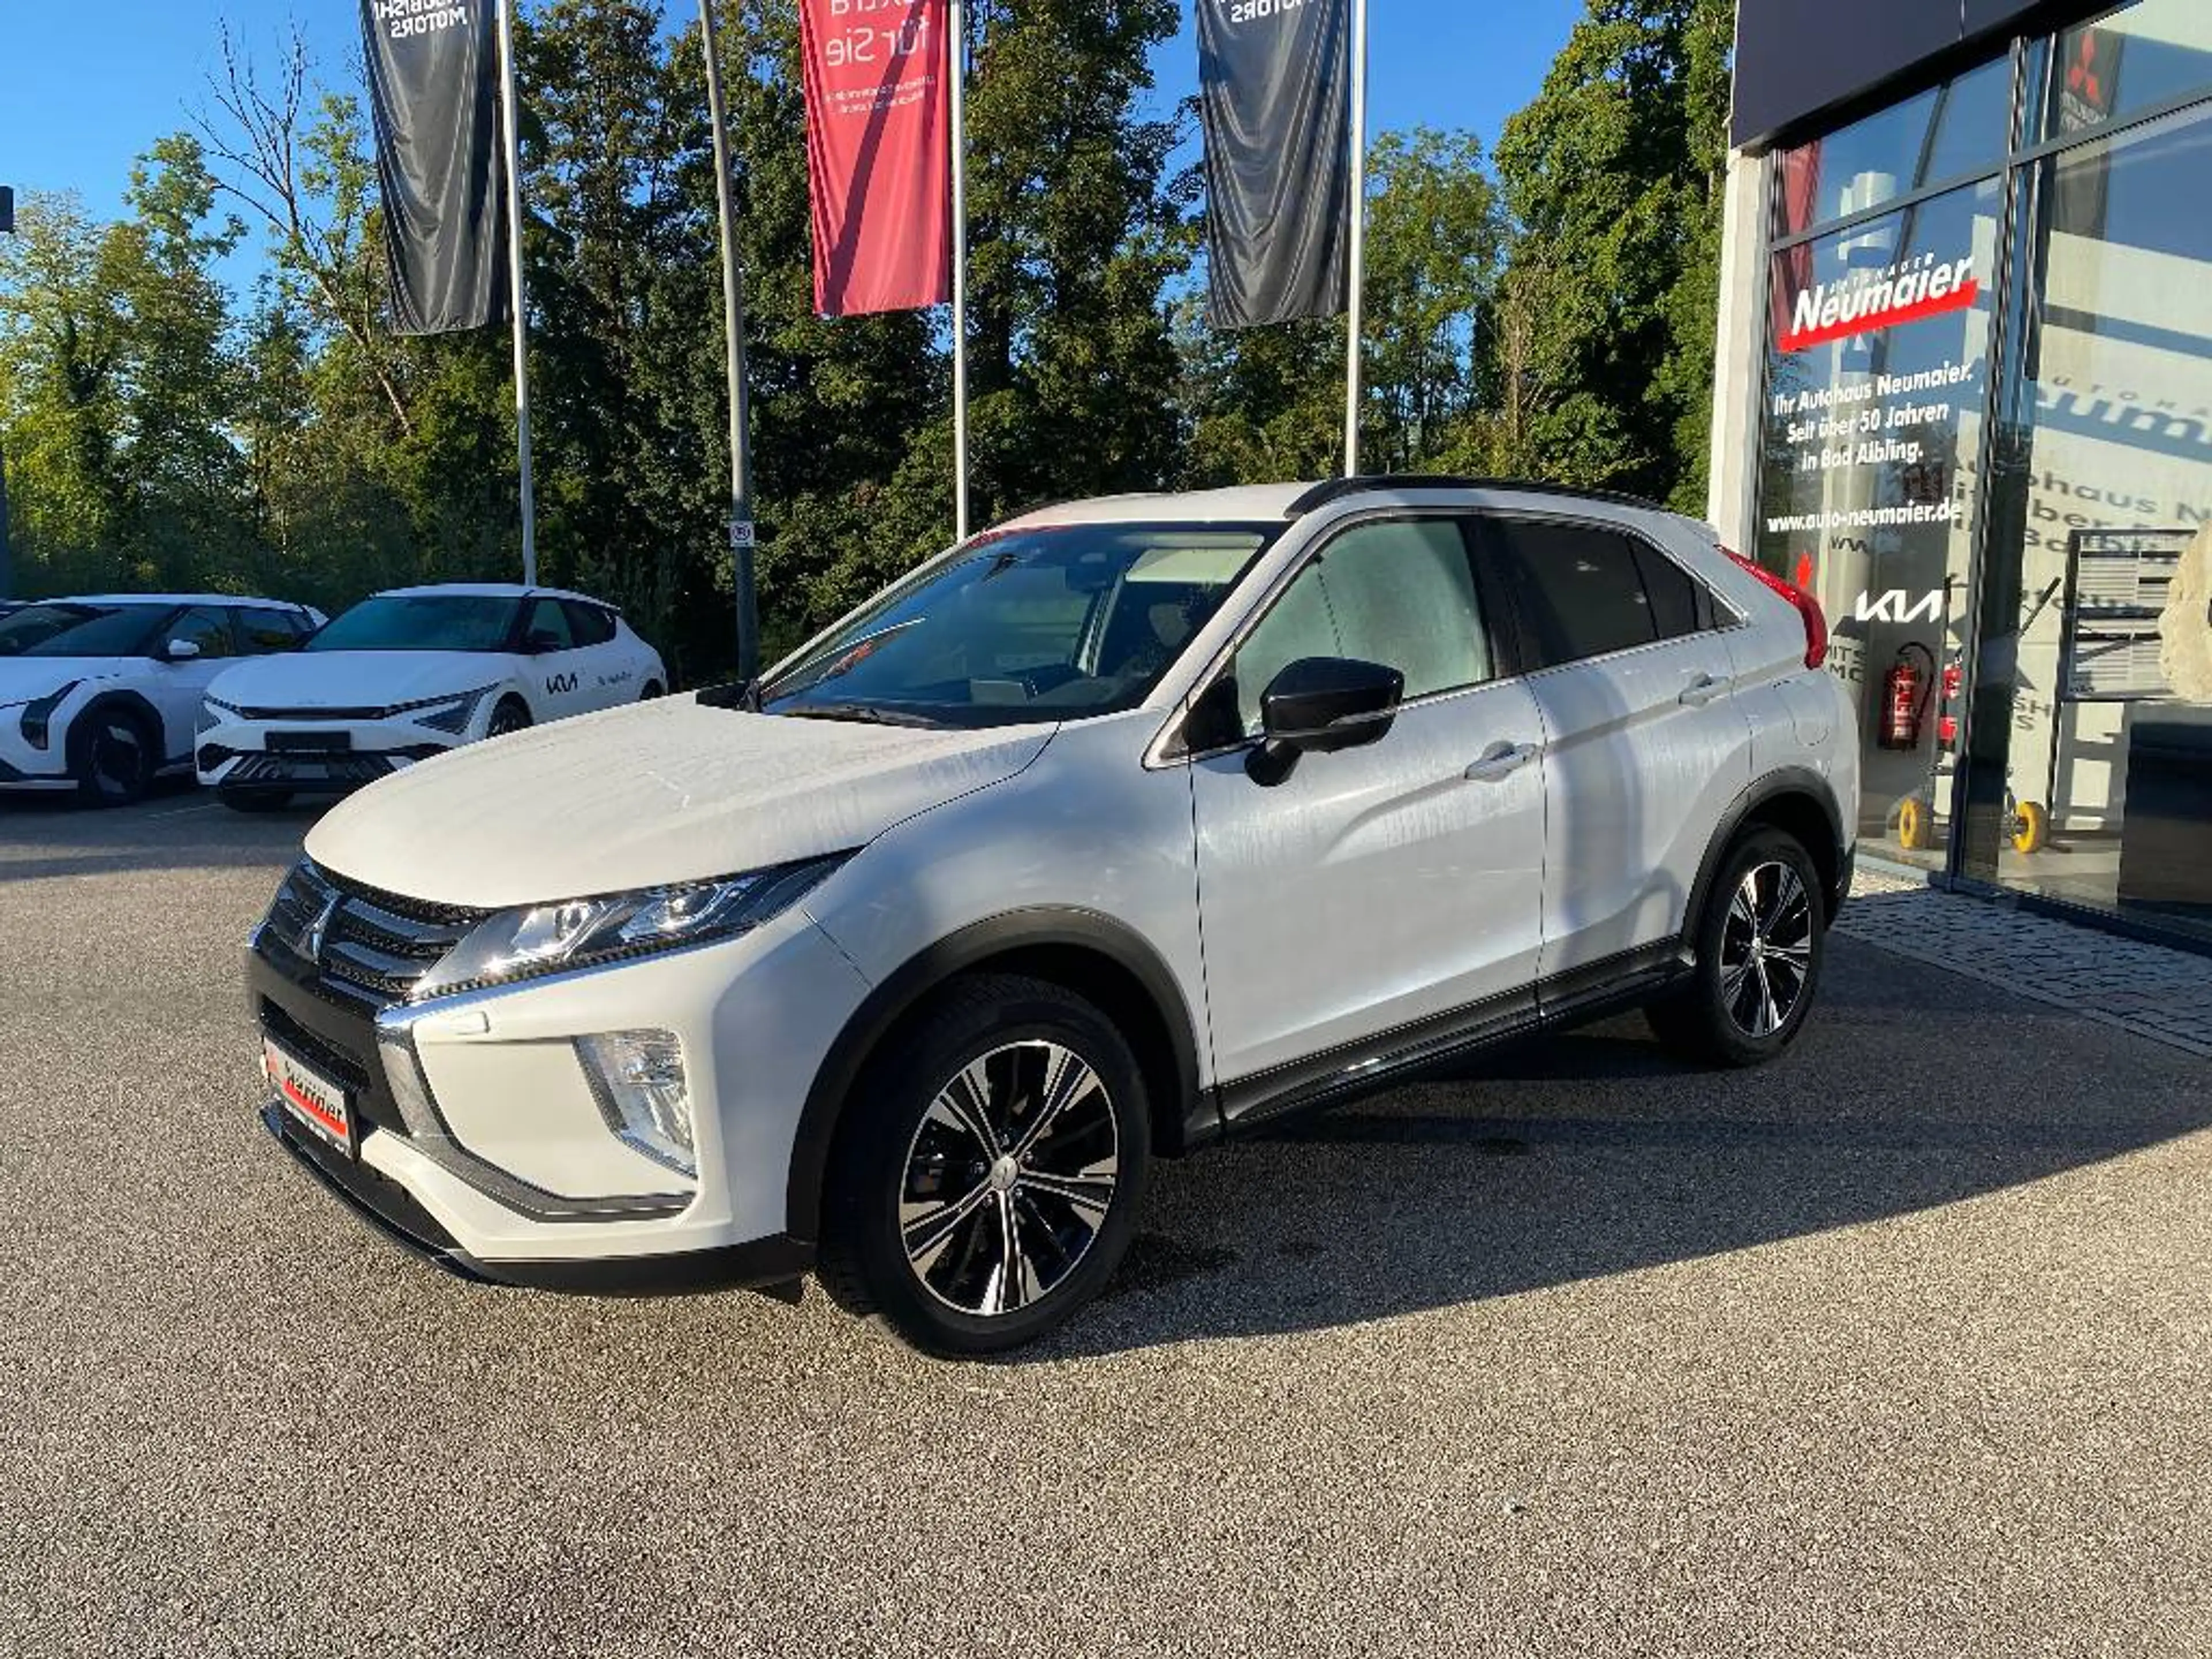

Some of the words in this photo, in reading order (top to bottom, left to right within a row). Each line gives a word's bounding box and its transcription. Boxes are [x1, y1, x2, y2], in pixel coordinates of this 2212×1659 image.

[1791, 253, 1974, 336] Neumaier
[1774, 395, 1796, 415] Ihr
[1797, 381, 1872, 411] Autohaus
[1876, 361, 1974, 396] Neumaier.
[1787, 422, 1815, 443] Seit
[1819, 415, 1855, 437] über
[1859, 407, 1880, 433] 50
[1885, 402, 1949, 428] Jahren
[1802, 451, 1817, 471] in
[1821, 444, 1853, 468] Bad
[1855, 439, 1923, 465] Aibling.
[1767, 497, 1961, 532] www.auto-neumaier.de
[1855, 589, 1944, 623] KIA
